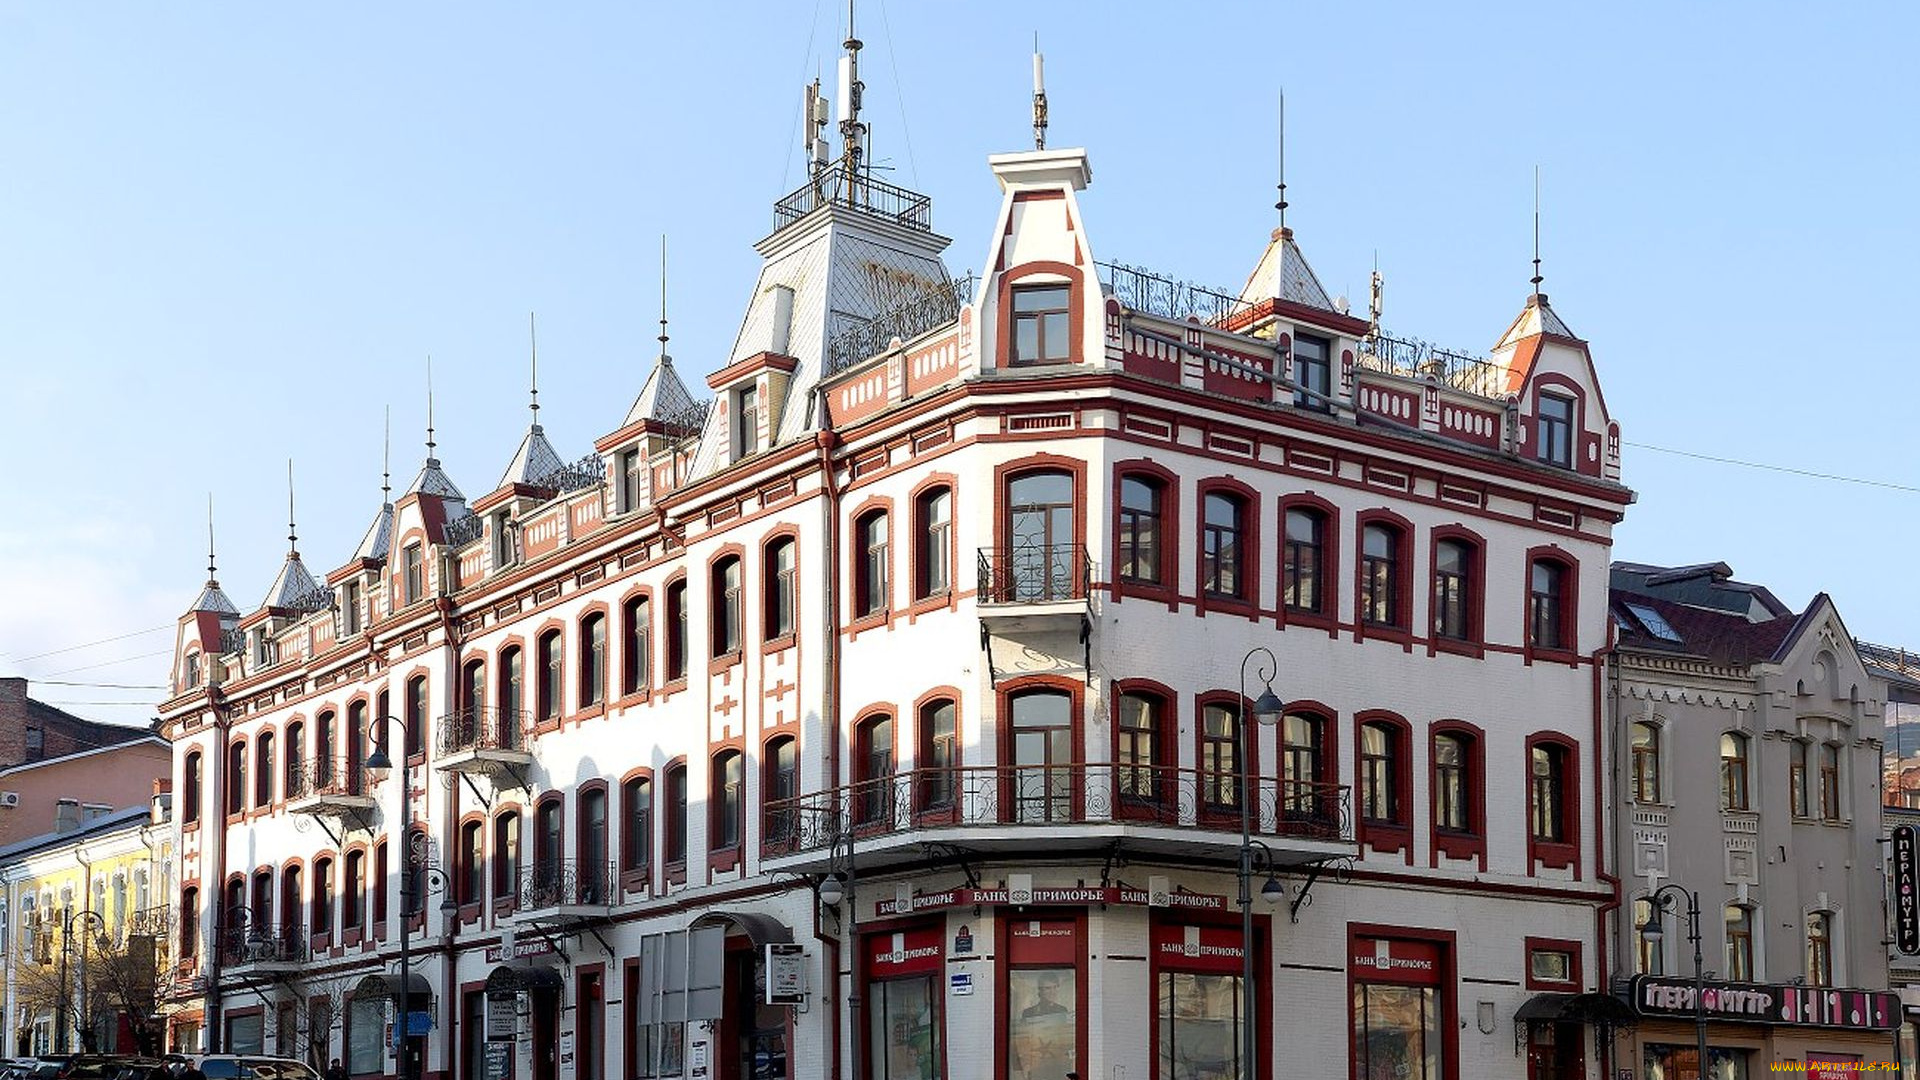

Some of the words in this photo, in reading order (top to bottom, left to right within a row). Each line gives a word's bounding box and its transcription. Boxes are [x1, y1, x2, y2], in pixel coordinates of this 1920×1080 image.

[880, 900, 897, 914] БАН
[913, 892, 955, 908] ПРИМОРЬЕ
[973, 891, 1008, 902] БАНК
[1033, 890, 1104, 901] ПРИМОРЬЕ
[1120, 891, 1149, 902] БАНК
[1168, 894, 1221, 908] ПРИМОРЬЕ
[1161, 943, 1185, 954] БАНК
[1355, 956, 1377, 966] БАНК
[1389, 958, 1432, 970] ПРИМОРЬЕ
